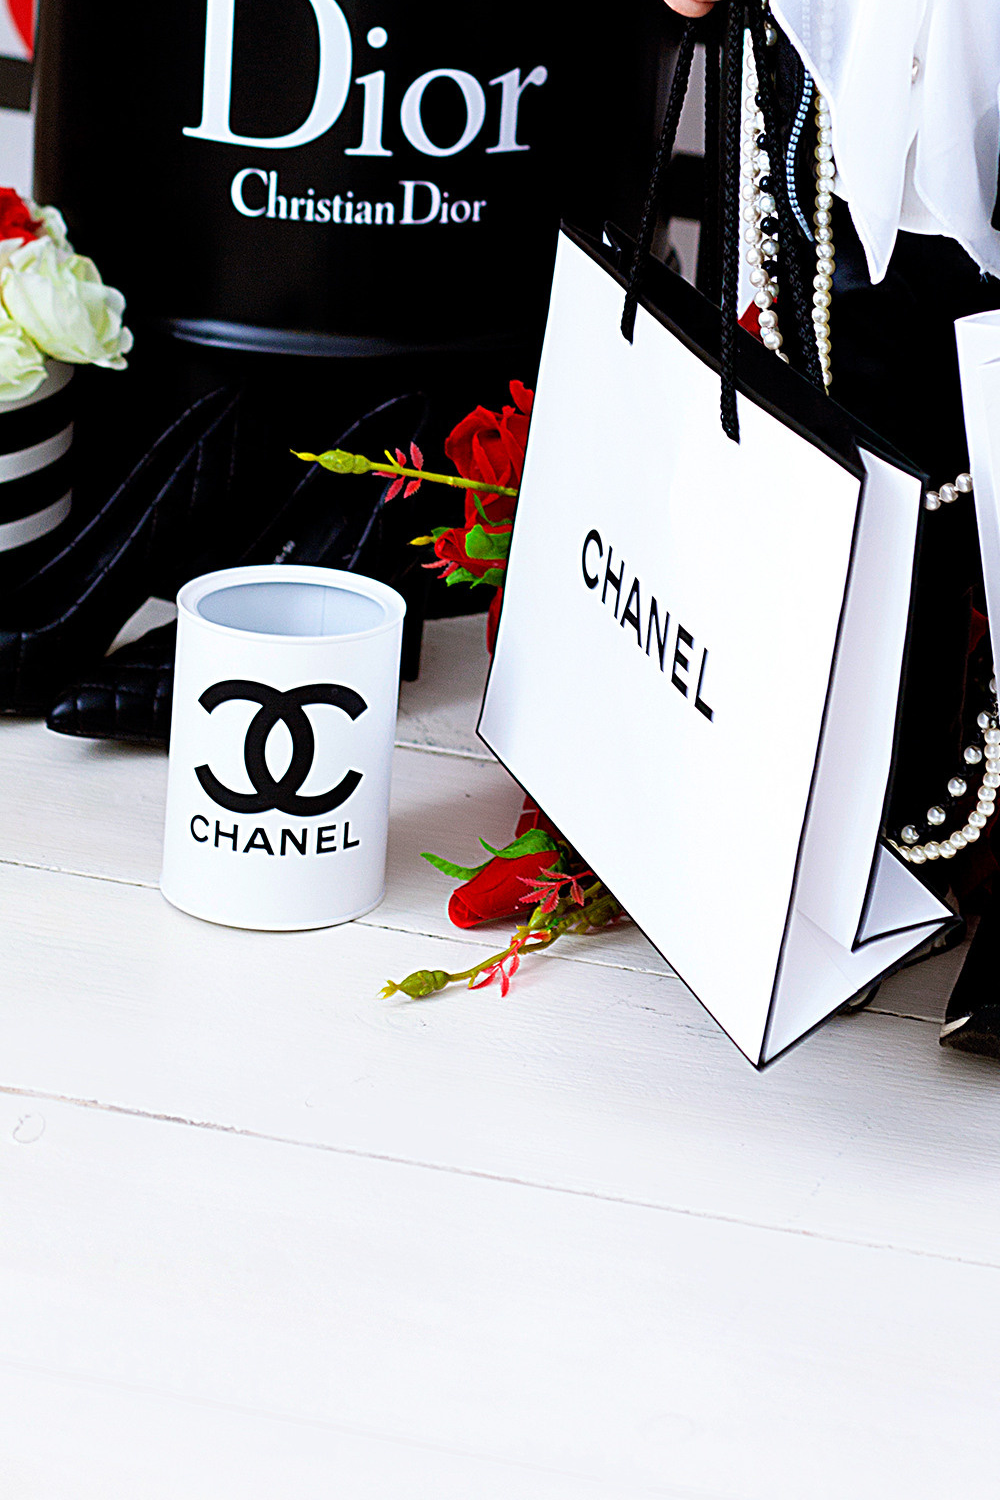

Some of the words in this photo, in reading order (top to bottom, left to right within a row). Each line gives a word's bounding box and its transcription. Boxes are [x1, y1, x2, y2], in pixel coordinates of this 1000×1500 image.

[230, 167, 395, 225] Christian
[399, 180, 487, 225] Dior
[581, 529, 714, 723] CHANEL
[189, 813, 361, 857] CHANEL
